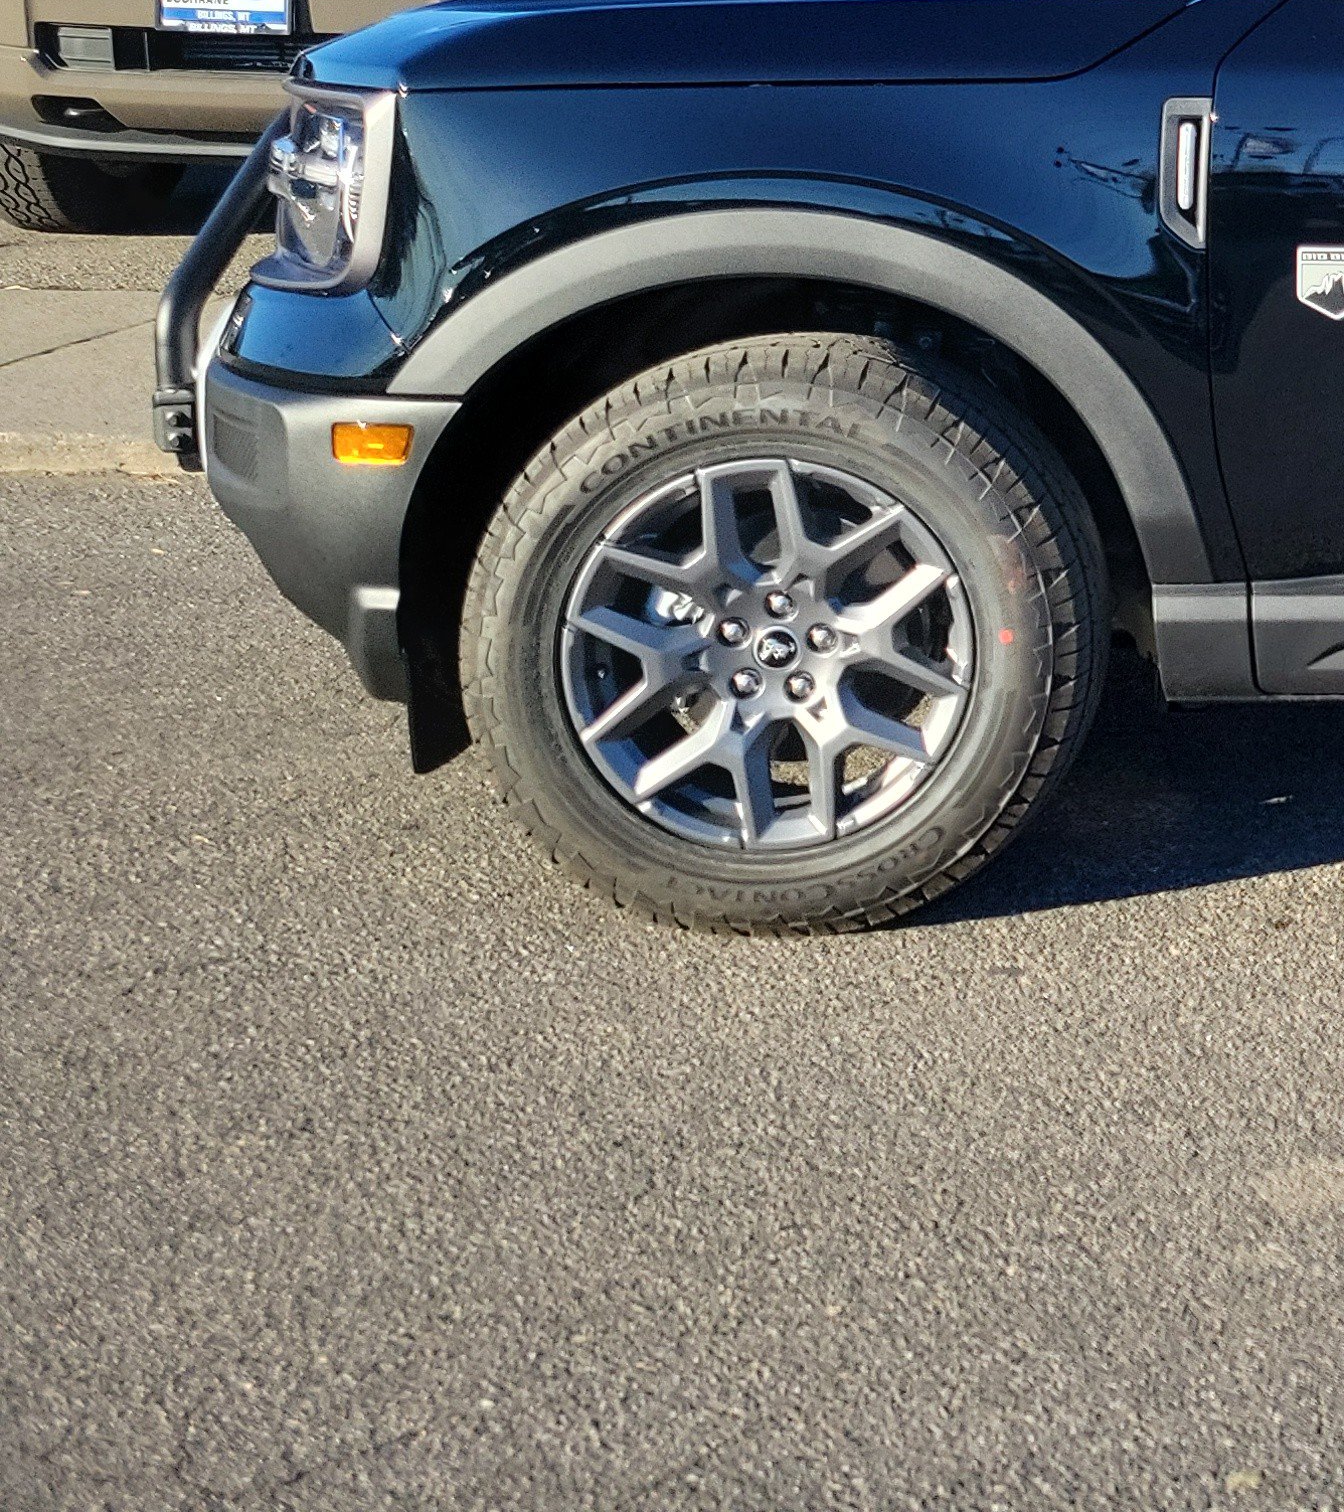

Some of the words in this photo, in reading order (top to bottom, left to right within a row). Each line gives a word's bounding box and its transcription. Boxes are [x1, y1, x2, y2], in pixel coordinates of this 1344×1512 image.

[239, 24, 257, 34] MT
[1302, 252, 1328, 261] BIG
[581, 408, 863, 493] CONTINENTAL
